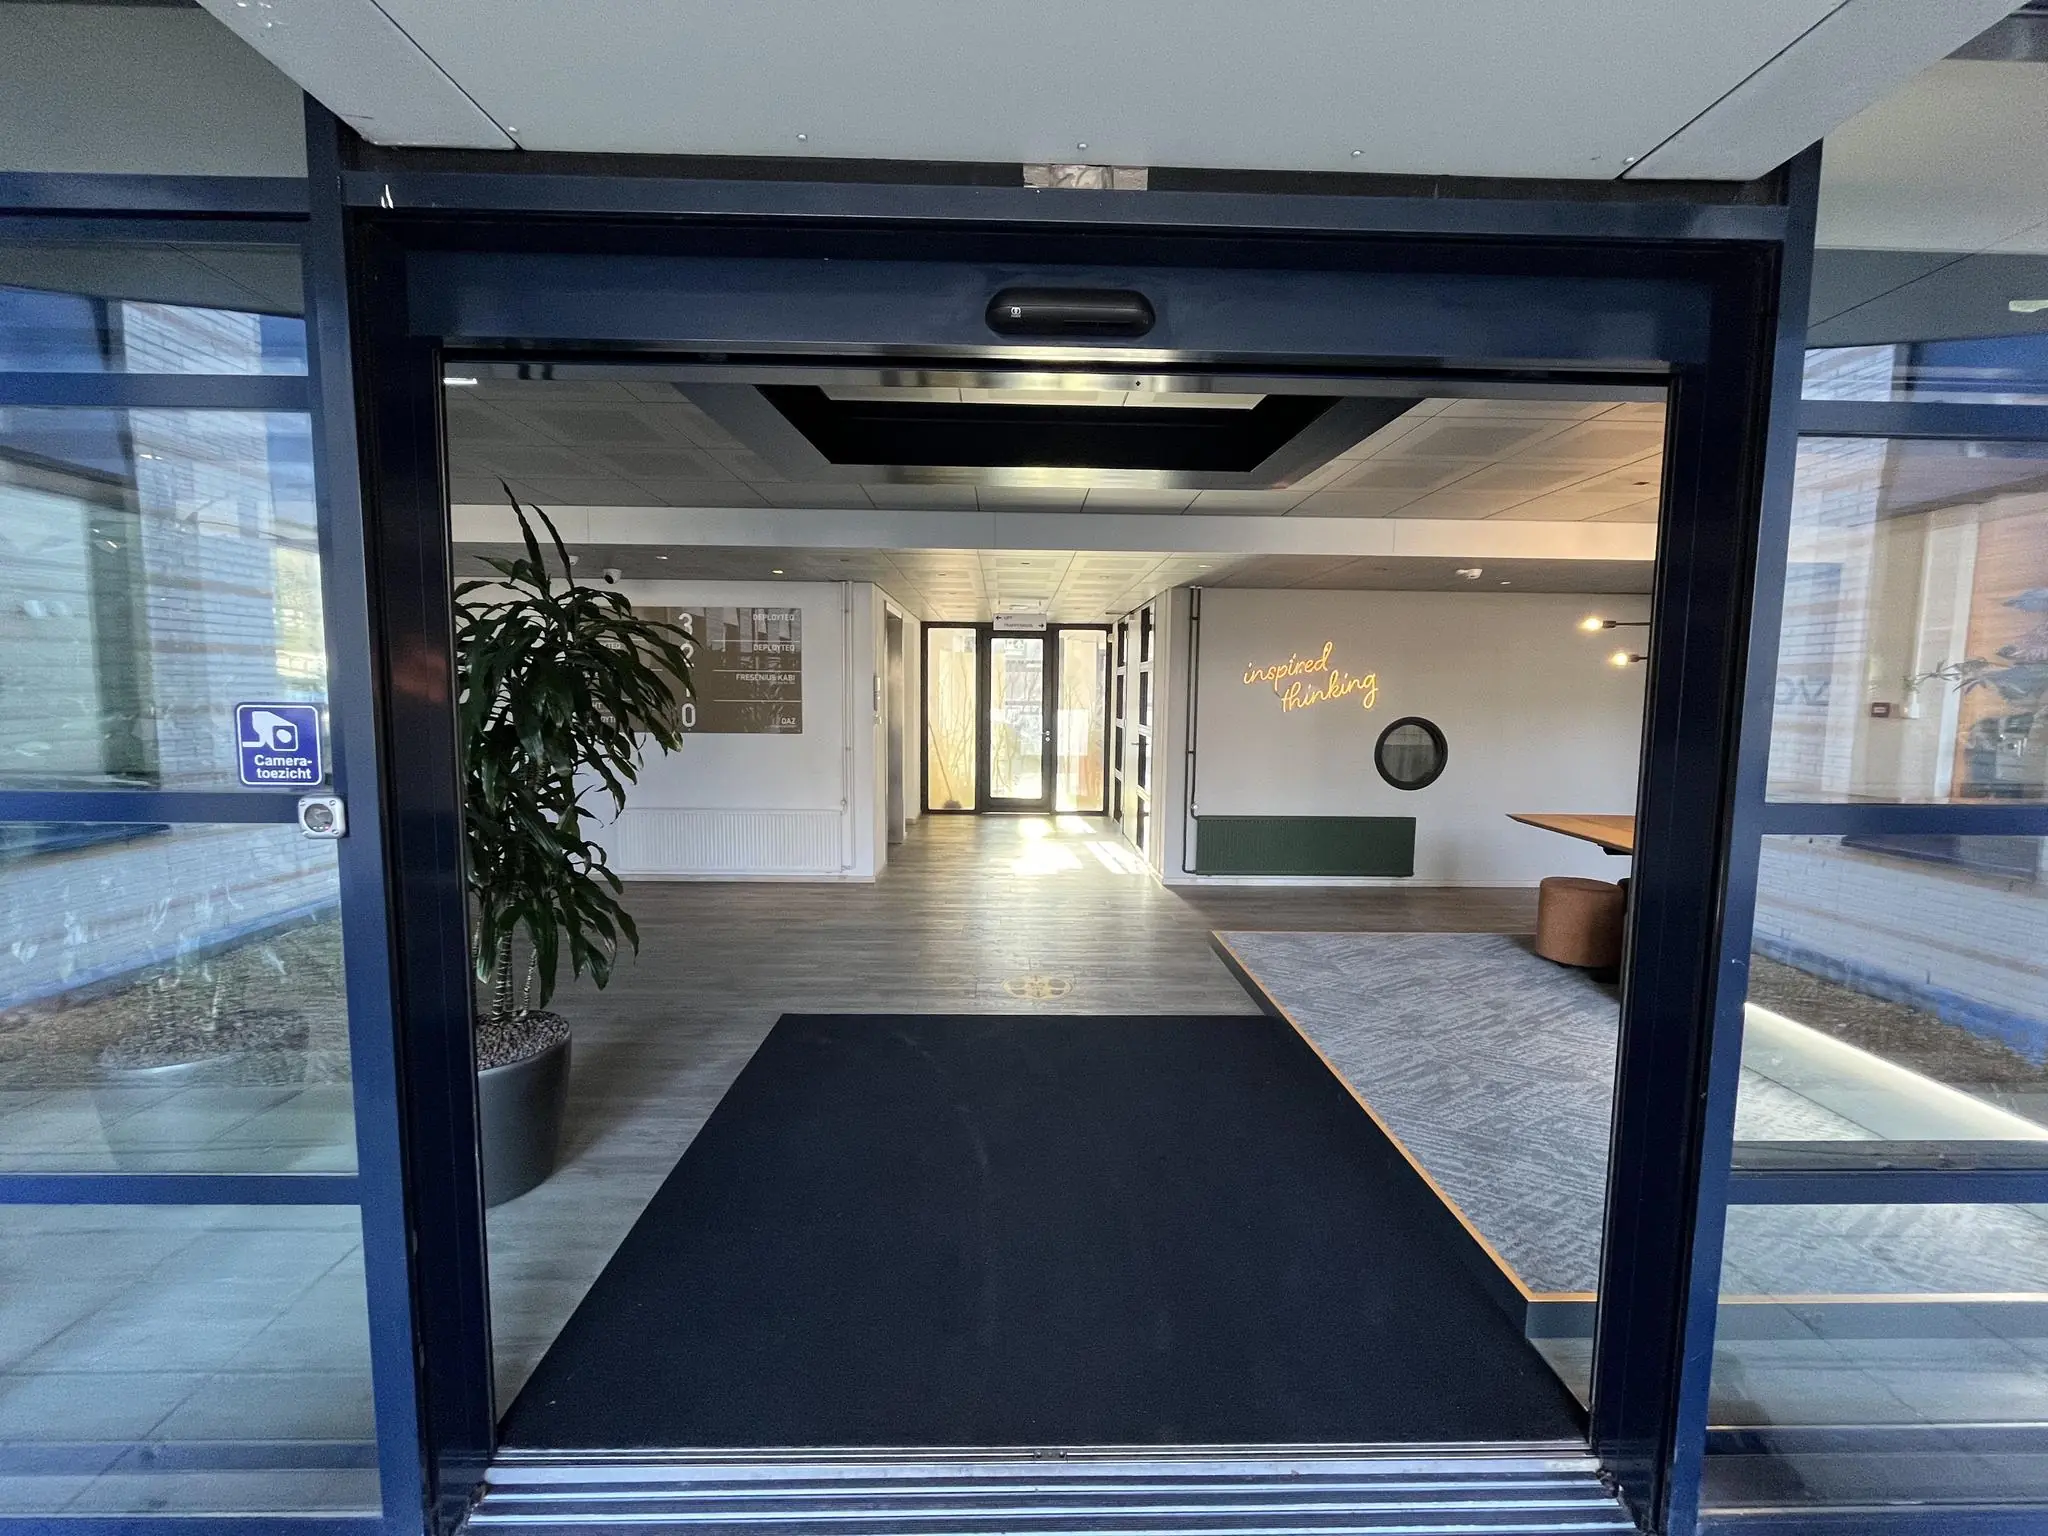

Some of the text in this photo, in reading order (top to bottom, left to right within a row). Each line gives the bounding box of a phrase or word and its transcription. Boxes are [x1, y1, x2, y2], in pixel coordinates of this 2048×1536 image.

[1243, 640, 1333, 691] inspired
[735, 673, 796, 682] FRESENIUS KABI
[1280, 670, 1379, 712] thinking
[681, 702, 696, 728] 0
[254, 754, 313, 766] Camera-
[256, 767, 312, 779] toezicht
